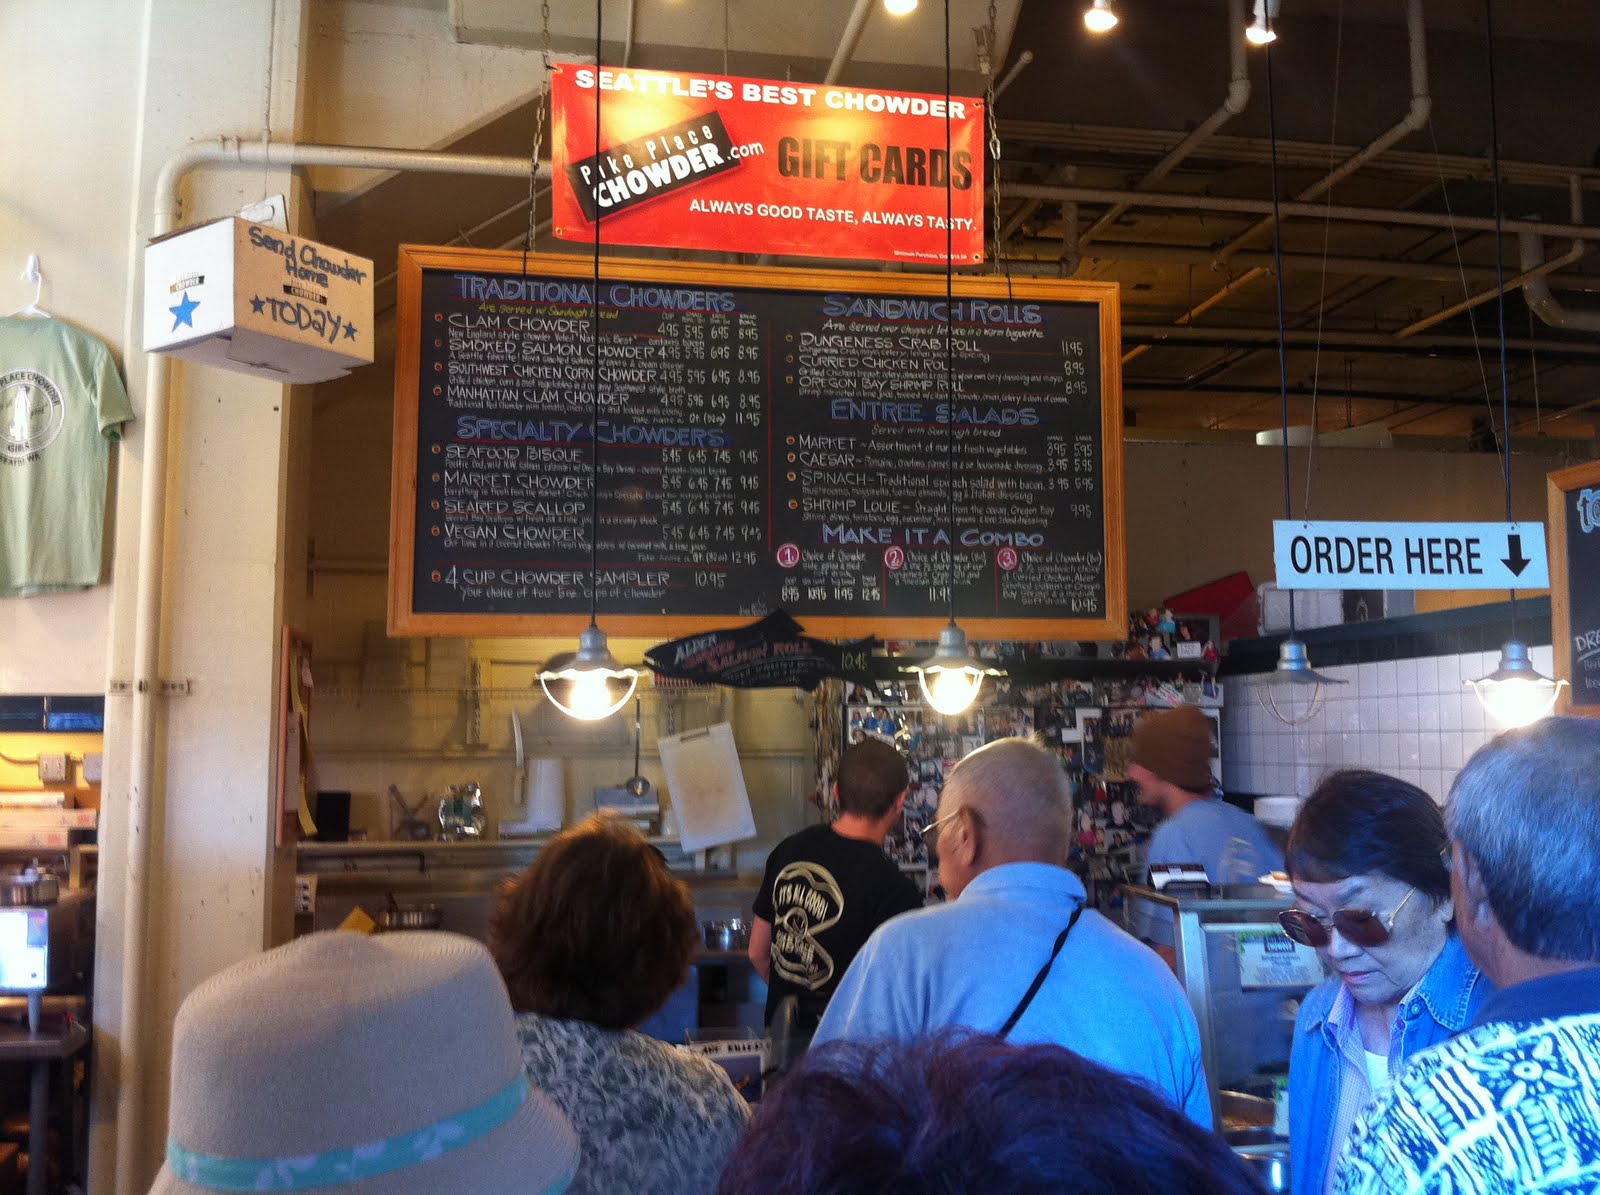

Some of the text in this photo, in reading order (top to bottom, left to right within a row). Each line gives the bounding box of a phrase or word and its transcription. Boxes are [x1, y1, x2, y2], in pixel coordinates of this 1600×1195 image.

[574, 68, 967, 121] SEATTLE'S BEST CHOWDER
[579, 122, 714, 187] Pike Place
[777, 135, 973, 192] GIFT CARDS
[592, 142, 725, 210] CHOWDER
[688, 198, 977, 232] ALWAYS GOOD TASTE, ALWAYS TASTY.
[248, 226, 367, 286] Send Chowder
[286, 258, 329, 289] Home
[454, 274, 736, 313] TRADITIONAL CHOWDERS
[822, 294, 1043, 325] SANDWICH ROLLS
[448, 312, 501, 329] CLAM
[507, 316, 591, 334] CHOWDER
[448, 340, 516, 355] SMOKED
[521, 342, 582, 356] SALMON
[586, 343, 655, 360] CHOWDER
[799, 331, 894, 350] DUNGENESS
[898, 336, 942, 353] CRAB
[945, 338, 982, 352] ROLL
[448, 361, 509, 376] SOUTHWEST
[512, 361, 562, 379] CHICKEN
[564, 365, 594, 381] CORN
[598, 367, 657, 383] CHOWDER
[799, 354, 860, 370] CURRIED
[862, 355, 919, 371] CHICKEN
[799, 375, 858, 391] OREGON
[861, 379, 888, 392] BAY
[889, 379, 934, 392] SHRIMP
[447, 386, 519, 402] MANHATTAN
[523, 389, 560, 404] CLAM
[564, 391, 630, 408] CHOWDER
[830, 398, 1040, 426] ENTREE SALADS
[456, 415, 725, 448] SPECIALTY CHOWDERS
[799, 433, 857, 450] MARKET
[446, 443, 520, 460] SEAFOOD
[526, 445, 585, 463] BISQUE
[799, 451, 856, 468] CAESAR
[444, 469, 511, 488] MARKET
[516, 473, 595, 490] CHOWDER
[800, 468, 867, 487] SPINACH
[444, 498, 509, 516] SEARED
[512, 499, 586, 516] SCALLOP
[802, 497, 857, 512] SHRIMP
[863, 498, 902, 514] LOUIE
[444, 522, 497, 540] VEGAN
[502, 524, 585, 542] CHOWDER
[822, 523, 1045, 547] MAKE IT A COMBO
[1290, 535, 1484, 576] ORDER HERE
[444, 564, 458, 590] 4
[462, 569, 496, 585] CUP
[500, 569, 584, 588] CHOWDER
[590, 570, 671, 587] SAMPLER
